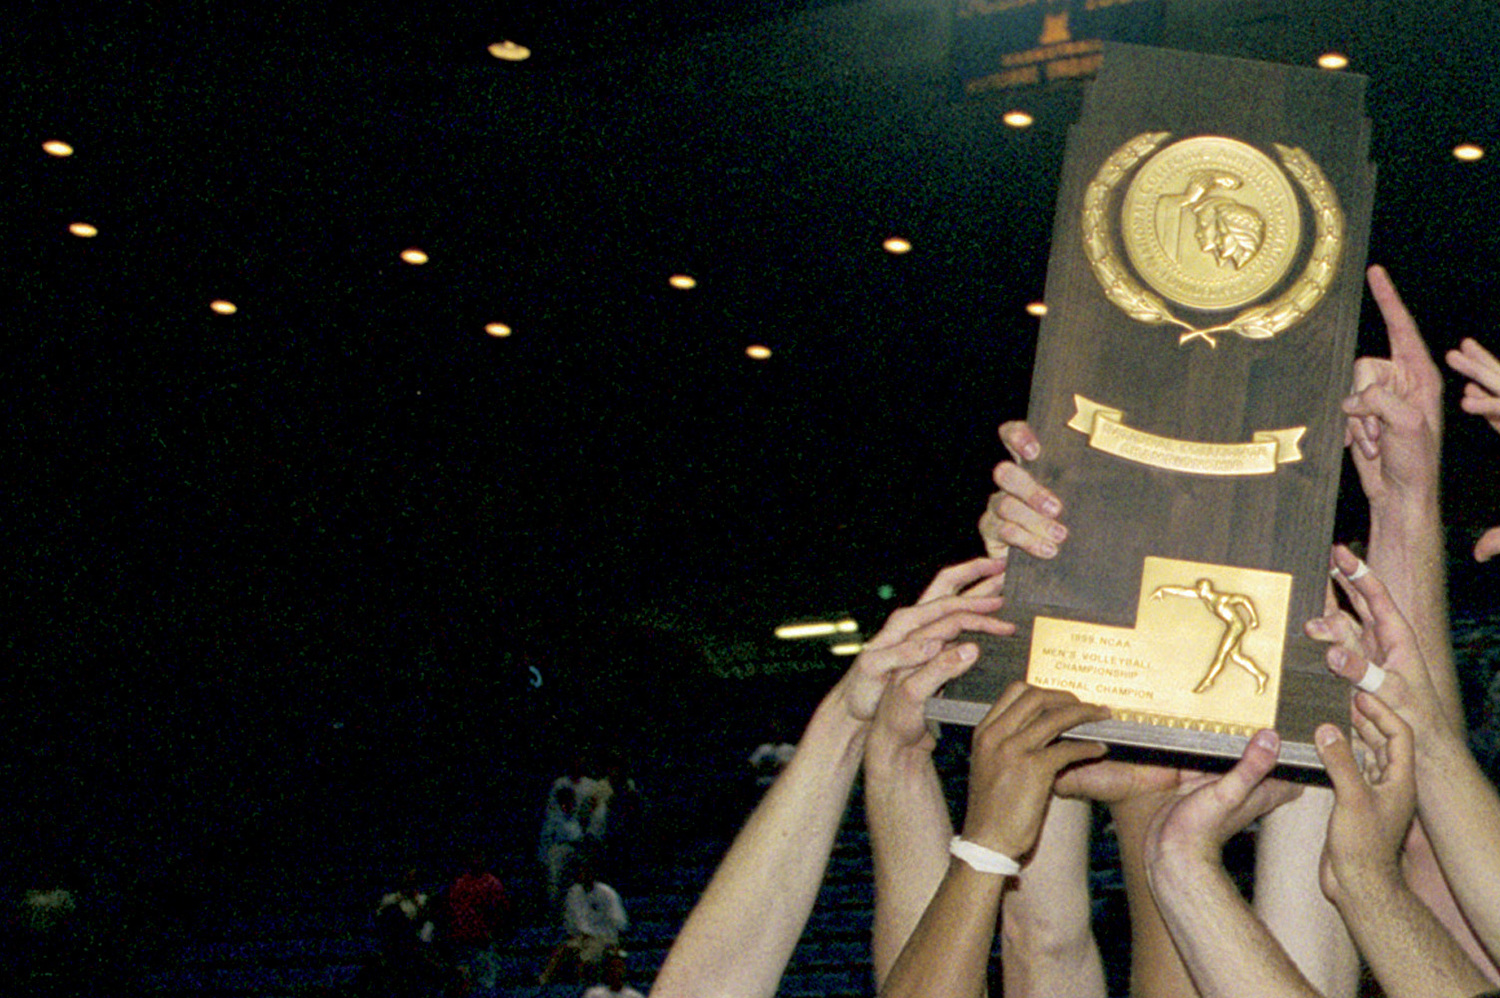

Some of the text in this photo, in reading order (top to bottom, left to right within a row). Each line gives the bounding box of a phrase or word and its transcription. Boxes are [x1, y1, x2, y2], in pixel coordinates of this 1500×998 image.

[1100, 637, 1131, 648] NCAA
[1082, 652, 1151, 669] VOLLEYBALL
[1055, 661, 1138, 678] CHAMPIONSHIP
[1034, 676, 1154, 699] NATIONAL CHAMPION
